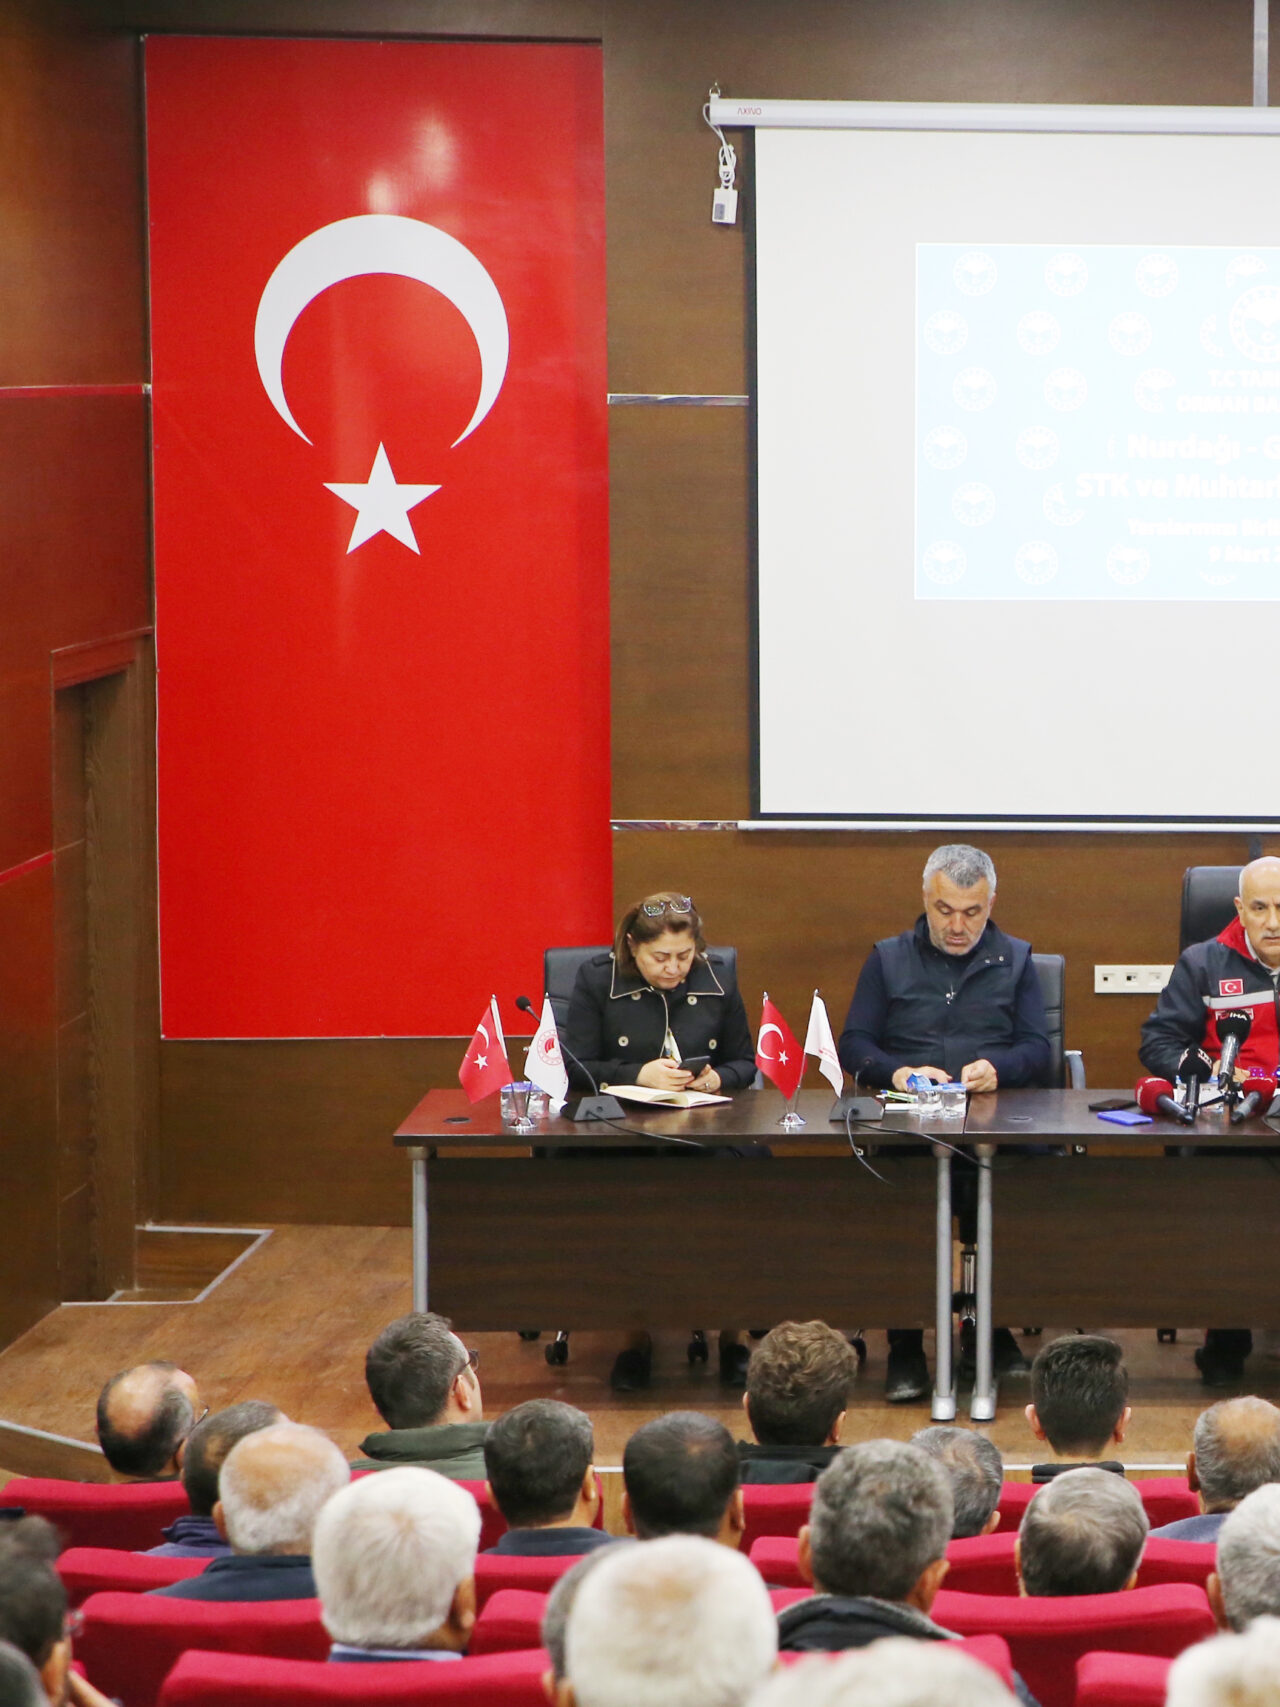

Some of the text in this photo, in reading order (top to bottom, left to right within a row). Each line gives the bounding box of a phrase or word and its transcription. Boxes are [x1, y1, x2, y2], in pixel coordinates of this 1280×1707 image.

[1128, 433, 1241, 466] Nurdağı
[1076, 473, 1130, 498] STK
[1135, 478, 1169, 498] ve
